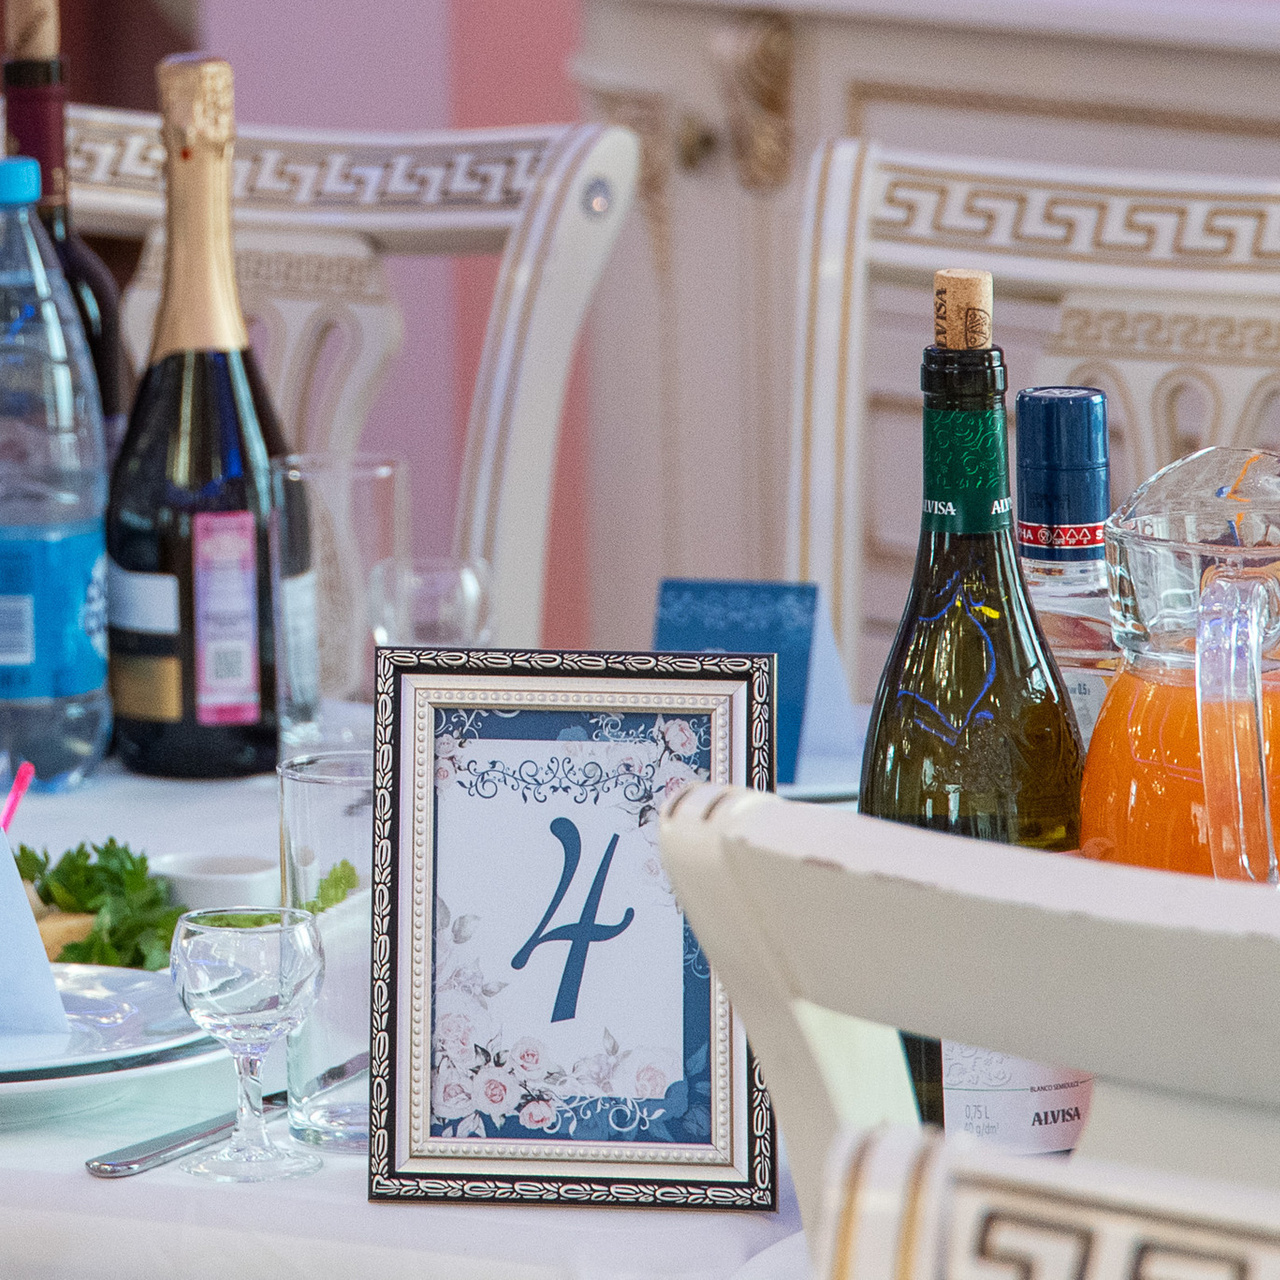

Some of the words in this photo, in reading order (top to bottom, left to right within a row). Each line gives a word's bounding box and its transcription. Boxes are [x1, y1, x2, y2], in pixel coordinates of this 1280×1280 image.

[934, 287, 947, 349] LVISA
[923, 499, 956, 516] LVISA
[510, 816, 635, 1023] 4
[1029, 1084, 1053, 1093] BLANCO
[965, 1104, 982, 1121] 0,75
[1031, 1106, 1081, 1126] ALVISA
